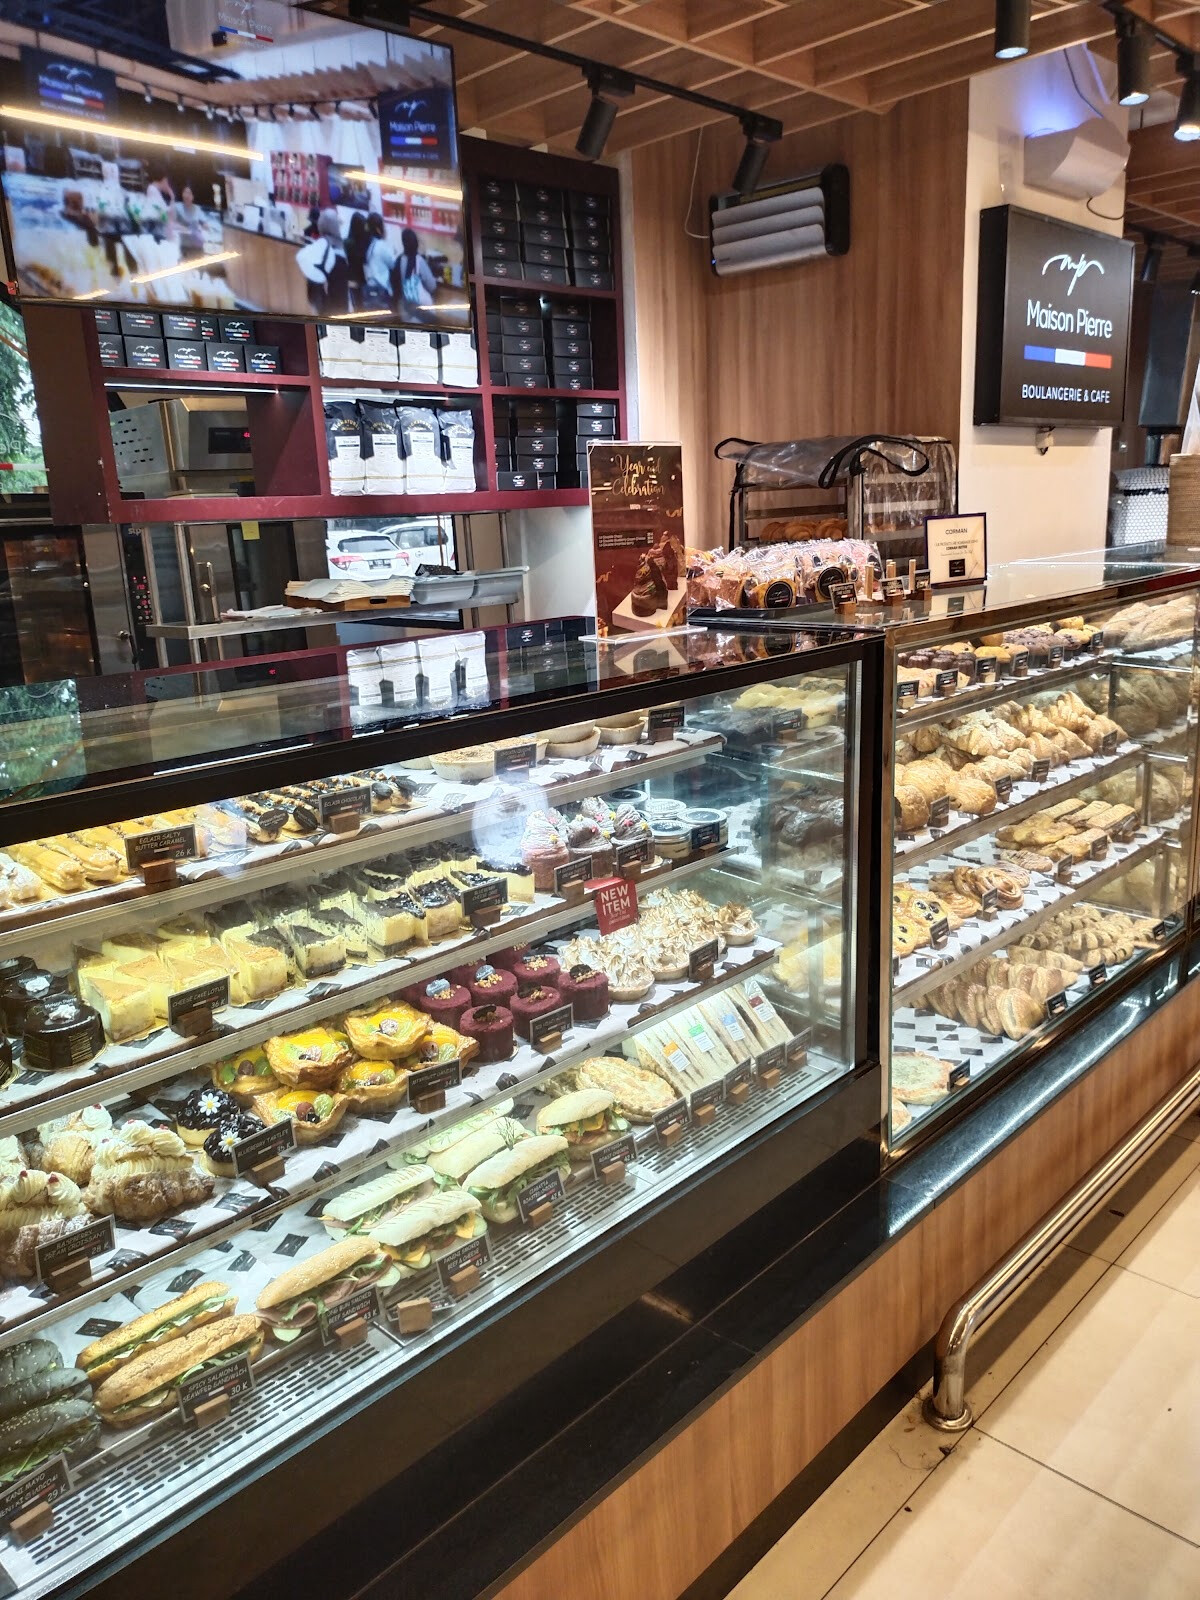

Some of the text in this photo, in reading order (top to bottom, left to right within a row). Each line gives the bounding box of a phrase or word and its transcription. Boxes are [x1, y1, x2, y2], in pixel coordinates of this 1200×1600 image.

[1026, 299, 1113, 338] Maison Pierre
[1021, 384, 1111, 404] BOULANGERIE & CAFE
[614, 454, 645, 477] Year
[612, 474, 665, 497] Celebration
[323, 799, 341, 808] ECLAIR
[134, 836, 186, 852] BUTTER CARAMEL
[139, 831, 181, 845] ECLAIR SALTY
[186, 848, 192, 856] K
[600, 883, 629, 904] NEW
[602, 895, 631, 916] ITEM
[172, 985, 225, 1008] CHEESE CAKE LOTUS
[220, 998, 226, 1006] K
[67, 1229, 106, 1252] CROISSANT
[102, 1241, 110, 1251] K
[341, 1299, 371, 1318] SANDWICH
[363, 1307, 378, 1319] 43 K
[188, 1380, 206, 1393] SPICY
[207, 1366, 234, 1384] SALMON
[213, 1366, 247, 1388] SANDWICH
[231, 1380, 248, 1396] 30 K
[5, 1472, 46, 1503] KANI MAYO
[47, 1483, 67, 1502] 29 K
